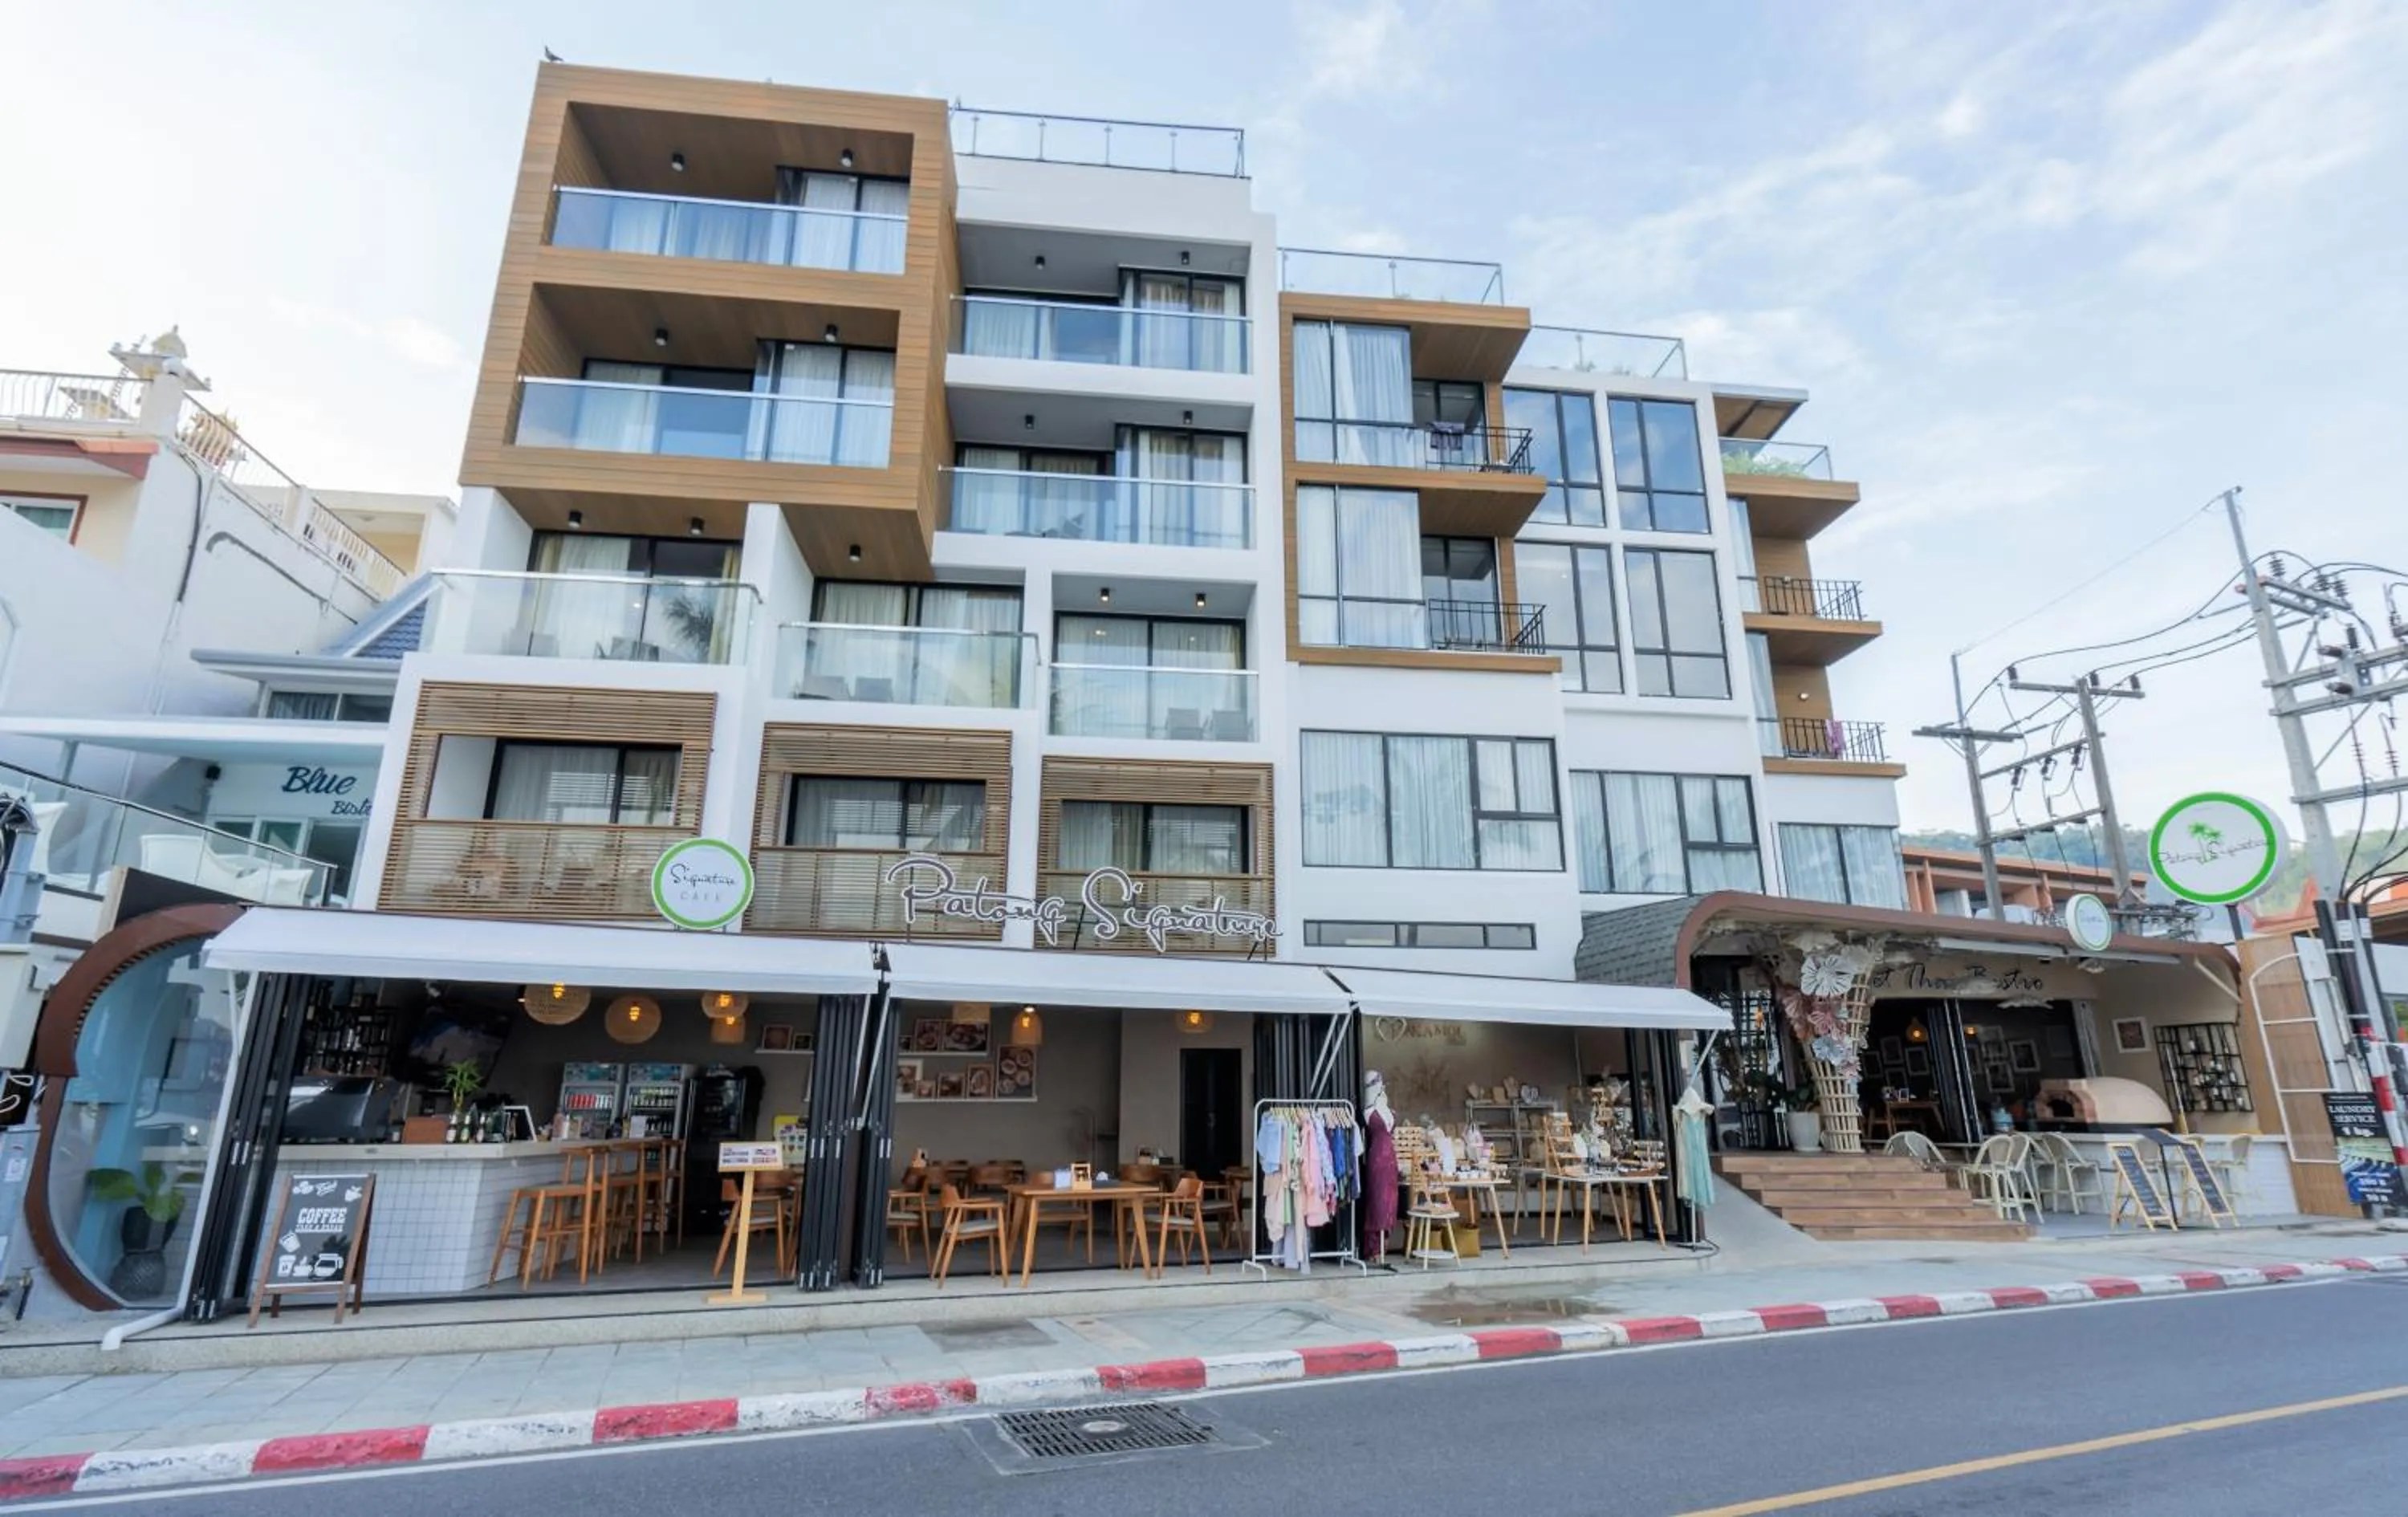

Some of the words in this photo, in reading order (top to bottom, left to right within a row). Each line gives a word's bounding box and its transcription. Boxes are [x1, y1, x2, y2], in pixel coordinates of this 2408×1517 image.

[282, 766, 357, 795] Blue
[886, 857, 1067, 946] Patong
[1082, 866, 1283, 953] Signature
[2329, 1105, 2376, 1113] LAUNDRY
[2333, 1115, 2377, 1123] SERVICE
[298, 1207, 348, 1224] COFFEE
